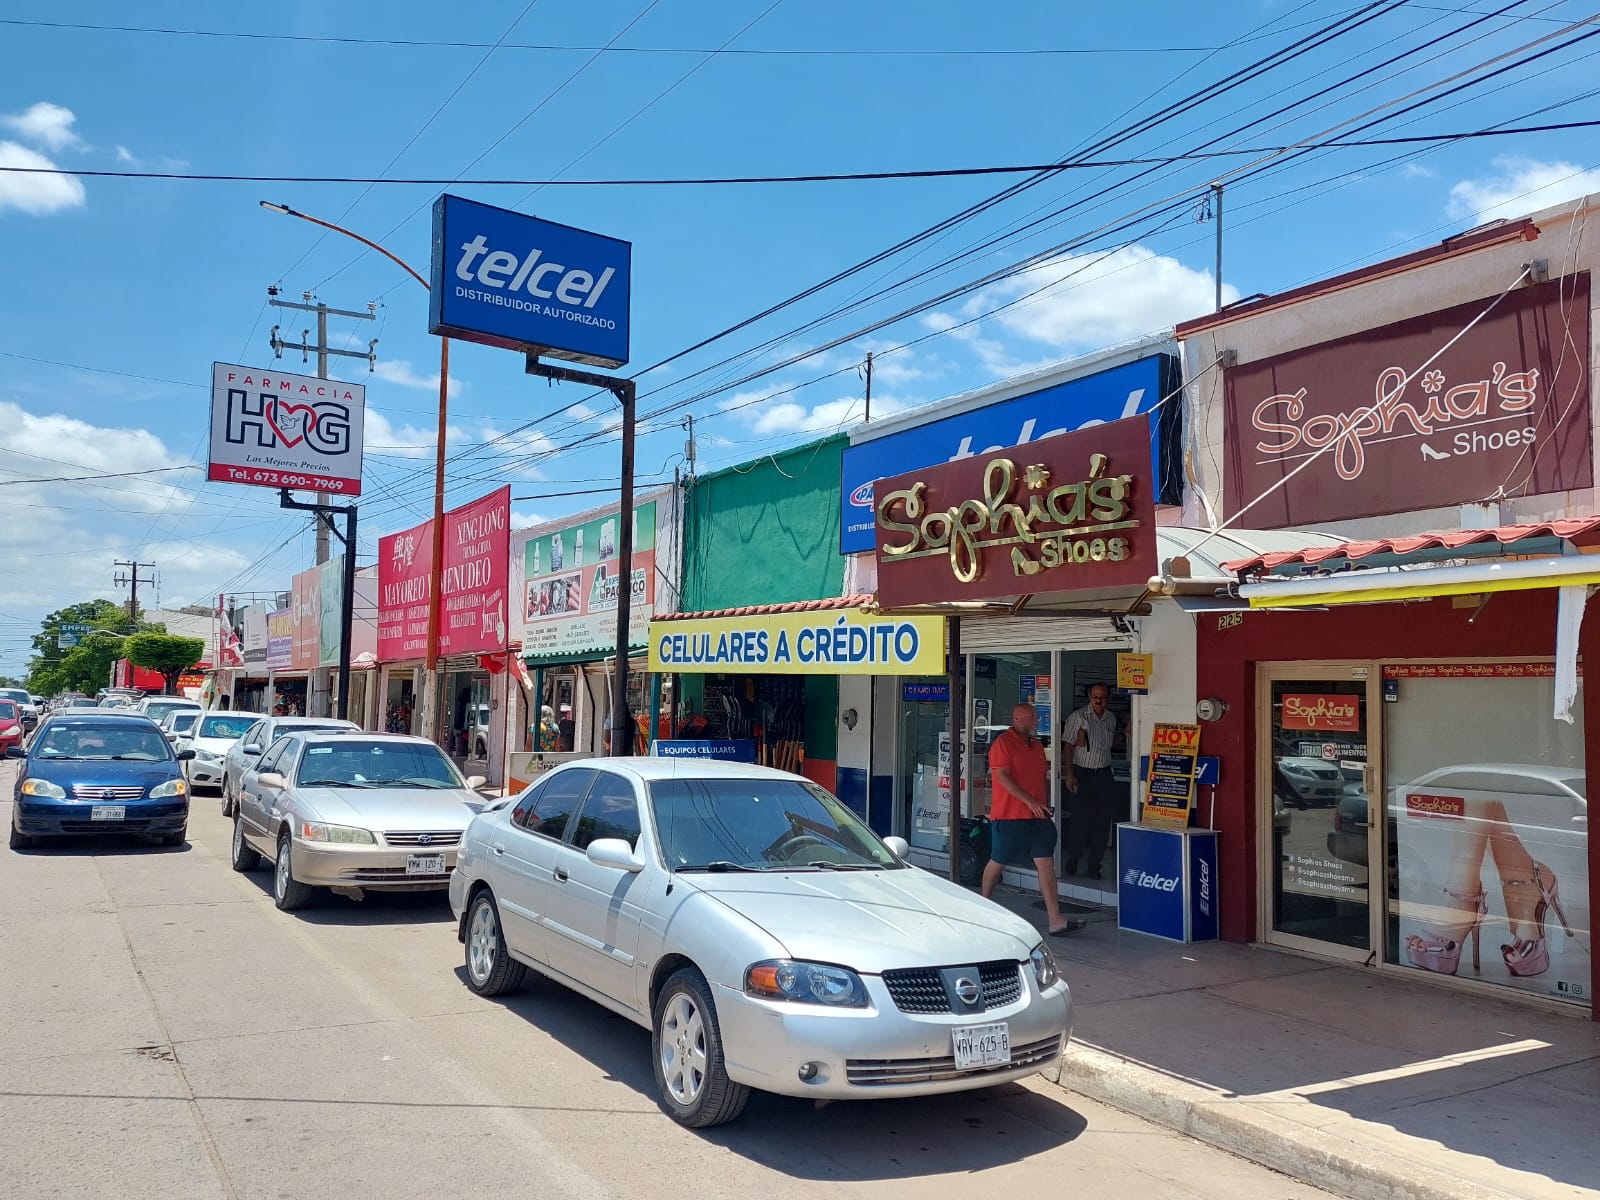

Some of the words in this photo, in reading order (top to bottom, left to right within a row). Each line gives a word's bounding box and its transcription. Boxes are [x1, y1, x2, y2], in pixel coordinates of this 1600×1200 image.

[456, 235, 616, 309] telcel
[455, 287, 541, 314] DISTRIBUIDOR
[543, 305, 616, 330] AUTORIZADO
[228, 373, 353, 400] FARMACIA
[1252, 362, 1541, 480] Sophia's
[1453, 425, 1537, 456] Shoes
[228, 468, 251, 480] Tel.
[253, 472, 278, 483] 673
[246, 454, 262, 464] Los
[264, 457, 298, 469] Mejores
[300, 461, 331, 472] Precios
[457, 518, 478, 546] XING
[479, 504, 505, 538] LONG
[877, 453, 1135, 584] Sophia's
[1040, 533, 1130, 569] Shoes
[384, 575, 426, 607] MAYOREO
[440, 557, 492, 596] MENUDEO
[1219, 612, 1242, 629] 225
[659, 630, 769, 664] CELULARES
[774, 630, 791, 663] A
[797, 615, 919, 663] CRÉDITO
[1285, 697, 1355, 726] Sophia's
[664, 746, 697, 754] EQUIPOS
[697, 746, 736, 754] CELULARES
[1153, 729, 1199, 745] HOY
[922, 808, 942, 820] telcel
[1411, 796, 1459, 816] Sophia's
[1297, 856, 1322, 867] Sophias
[1137, 871, 1179, 893] telcel
[1199, 858, 1209, 901] telcel
[956, 1033, 1008, 1058] VRV-625-B
